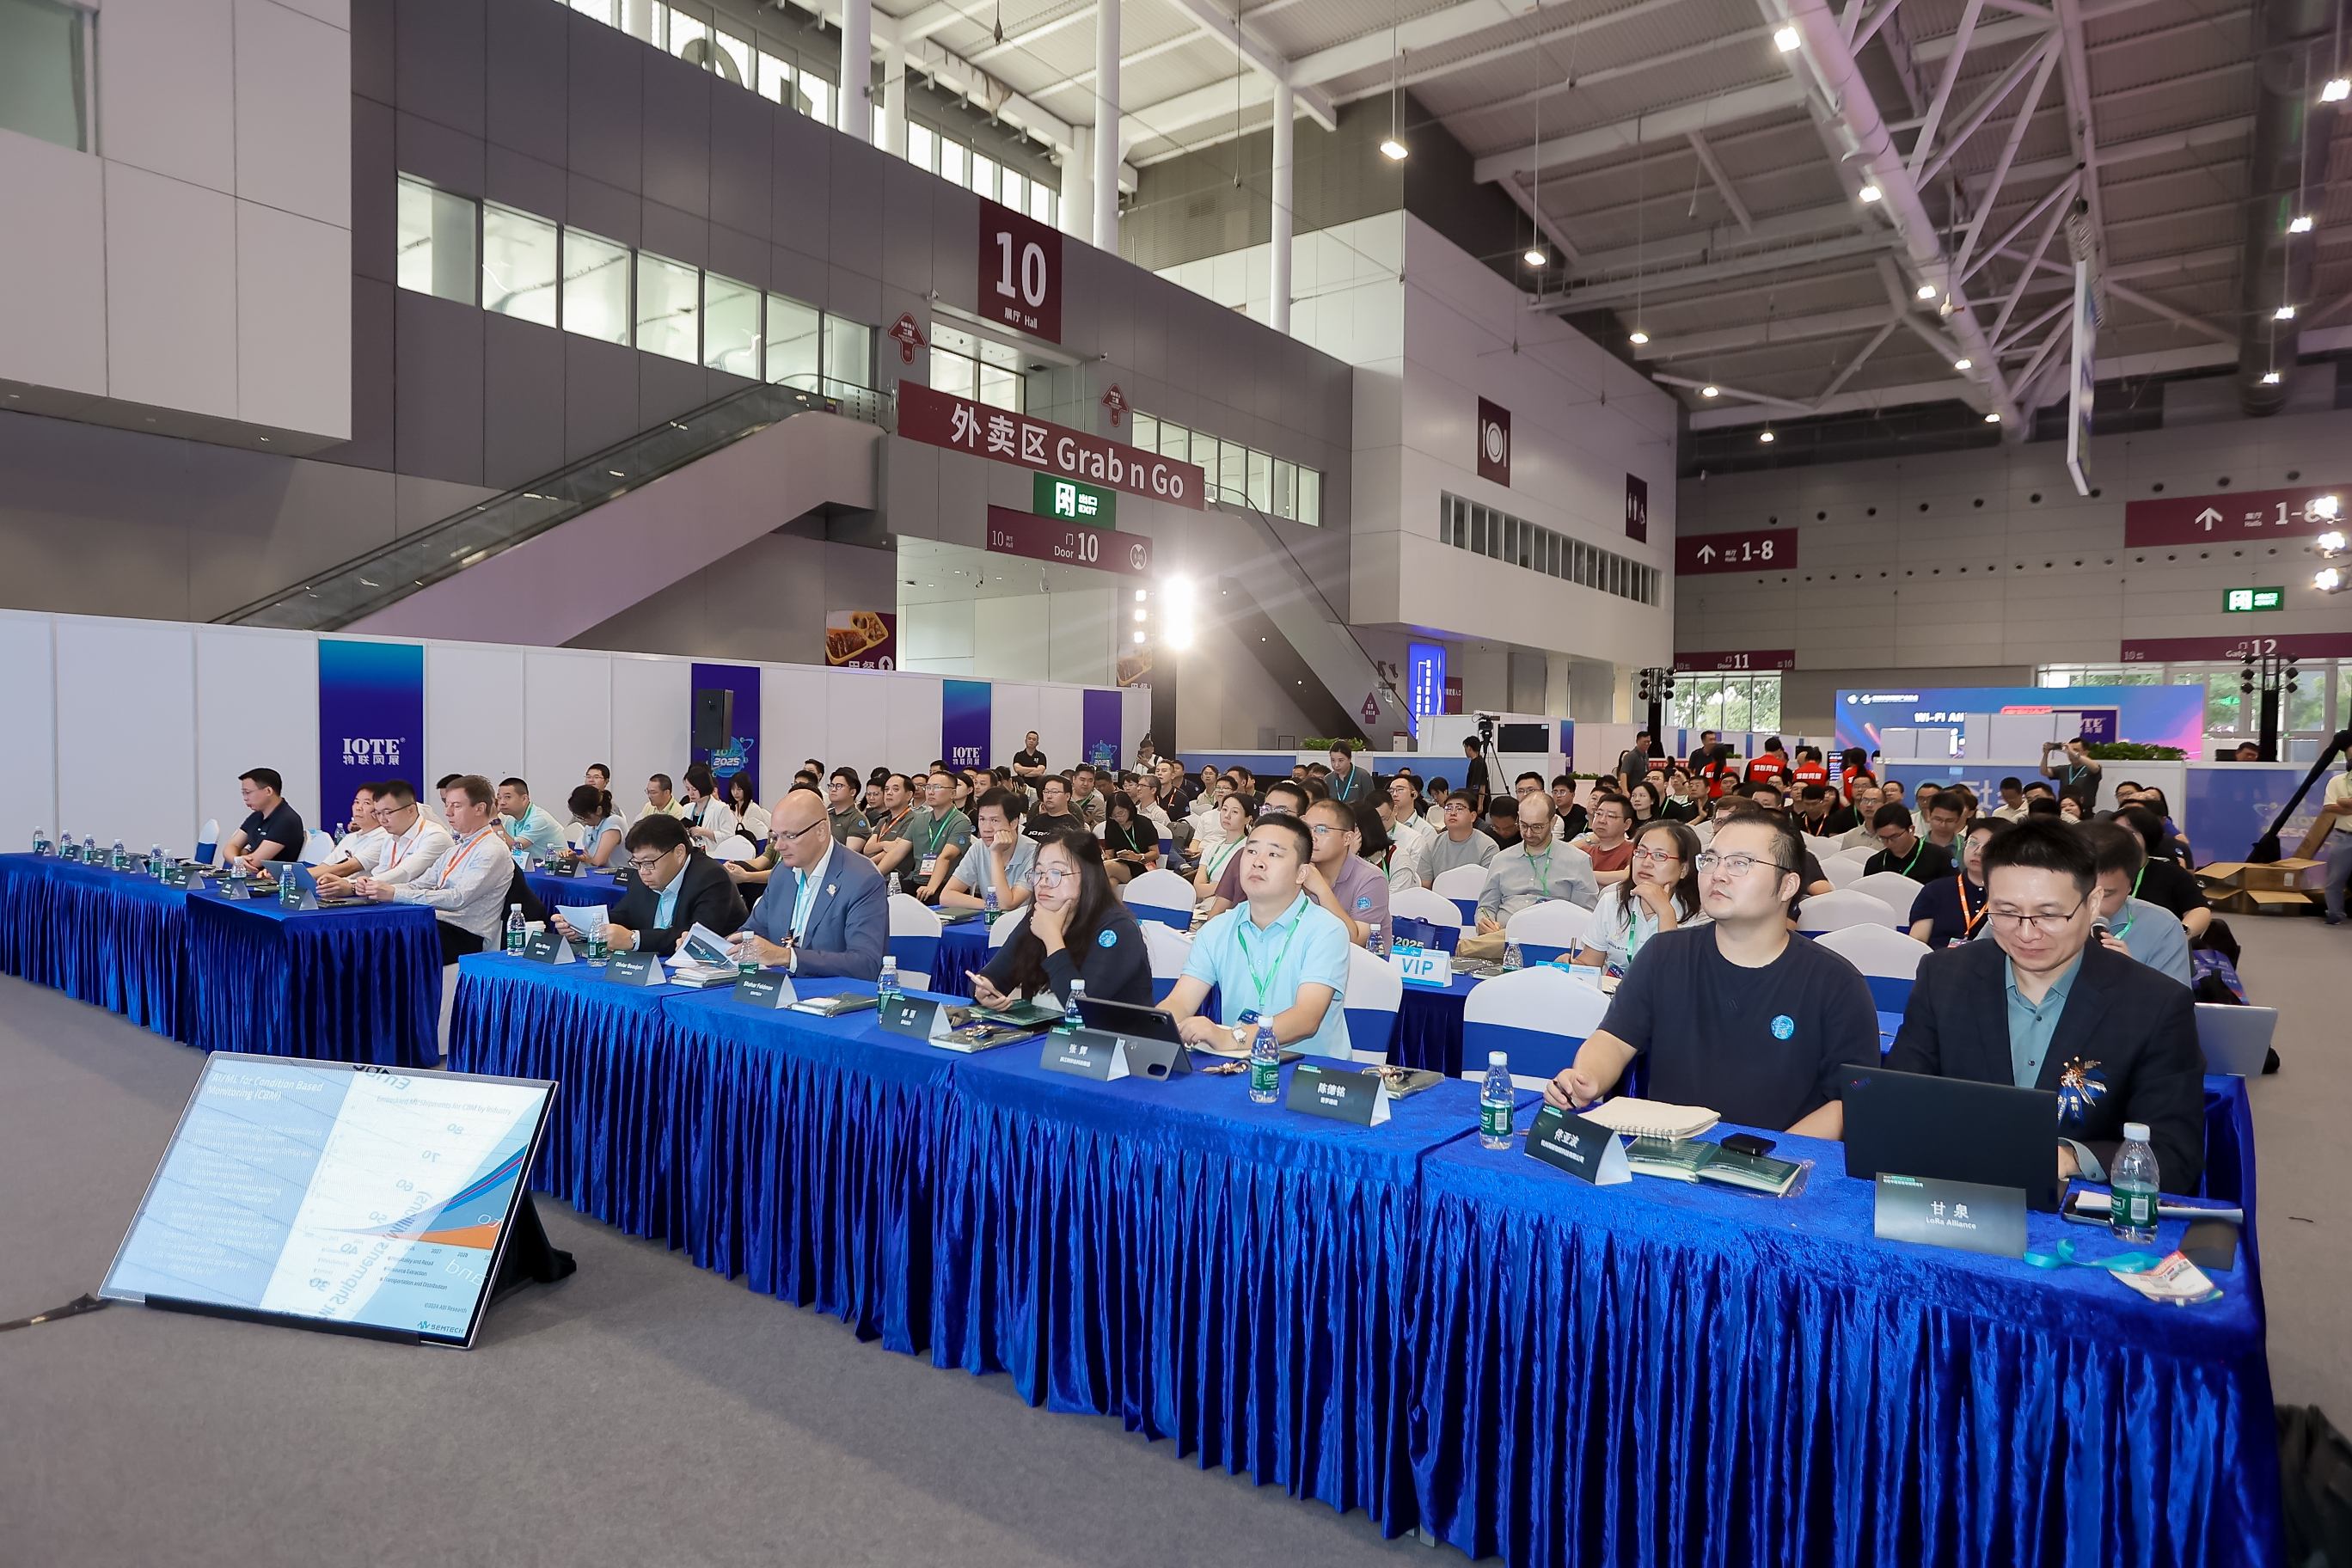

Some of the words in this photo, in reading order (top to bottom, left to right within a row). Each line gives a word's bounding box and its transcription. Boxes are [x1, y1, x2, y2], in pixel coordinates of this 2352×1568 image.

[996, 231, 1046, 308] 10
[1004, 307, 1021, 323] 展厅
[1025, 315, 1038, 329] Hall
[950, 403, 1048, 466] 外卖区
[1057, 437, 1124, 483] Grab
[1130, 462, 1145, 489] n
[1152, 463, 1184, 499] Go
[1078, 493, 1098, 506] 出口
[1078, 505, 1097, 516] EXIT
[992, 530, 1004, 547] 10
[1065, 532, 1074, 545] 门
[1054, 546, 1074, 559] Door
[1078, 532, 1099, 563] 10
[1742, 540, 1773, 561] 1-8
[2251, 639, 2277, 657] 12
[1734, 653, 1749, 669] 11
[343, 738, 400, 755] IOTE
[952, 747, 980, 758] IOTE
[343, 755, 400, 765] 物联网展
[713, 757, 740, 766] 2025
[1394, 935, 1424, 949] 2025
[1402, 958, 1434, 976] VIP
[240, 1075, 252, 1084] for
[254, 1076, 295, 1088] Condition
[296, 1080, 324, 1092] Based
[487, 1106, 512, 1117] Industry
[1931, 1201, 1969, 1219] 甘泉
[1926, 1216, 1945, 1226] LoRa
[1946, 1219, 1976, 1230] Alliance
[431, 1325, 464, 1333] SEMTECH
